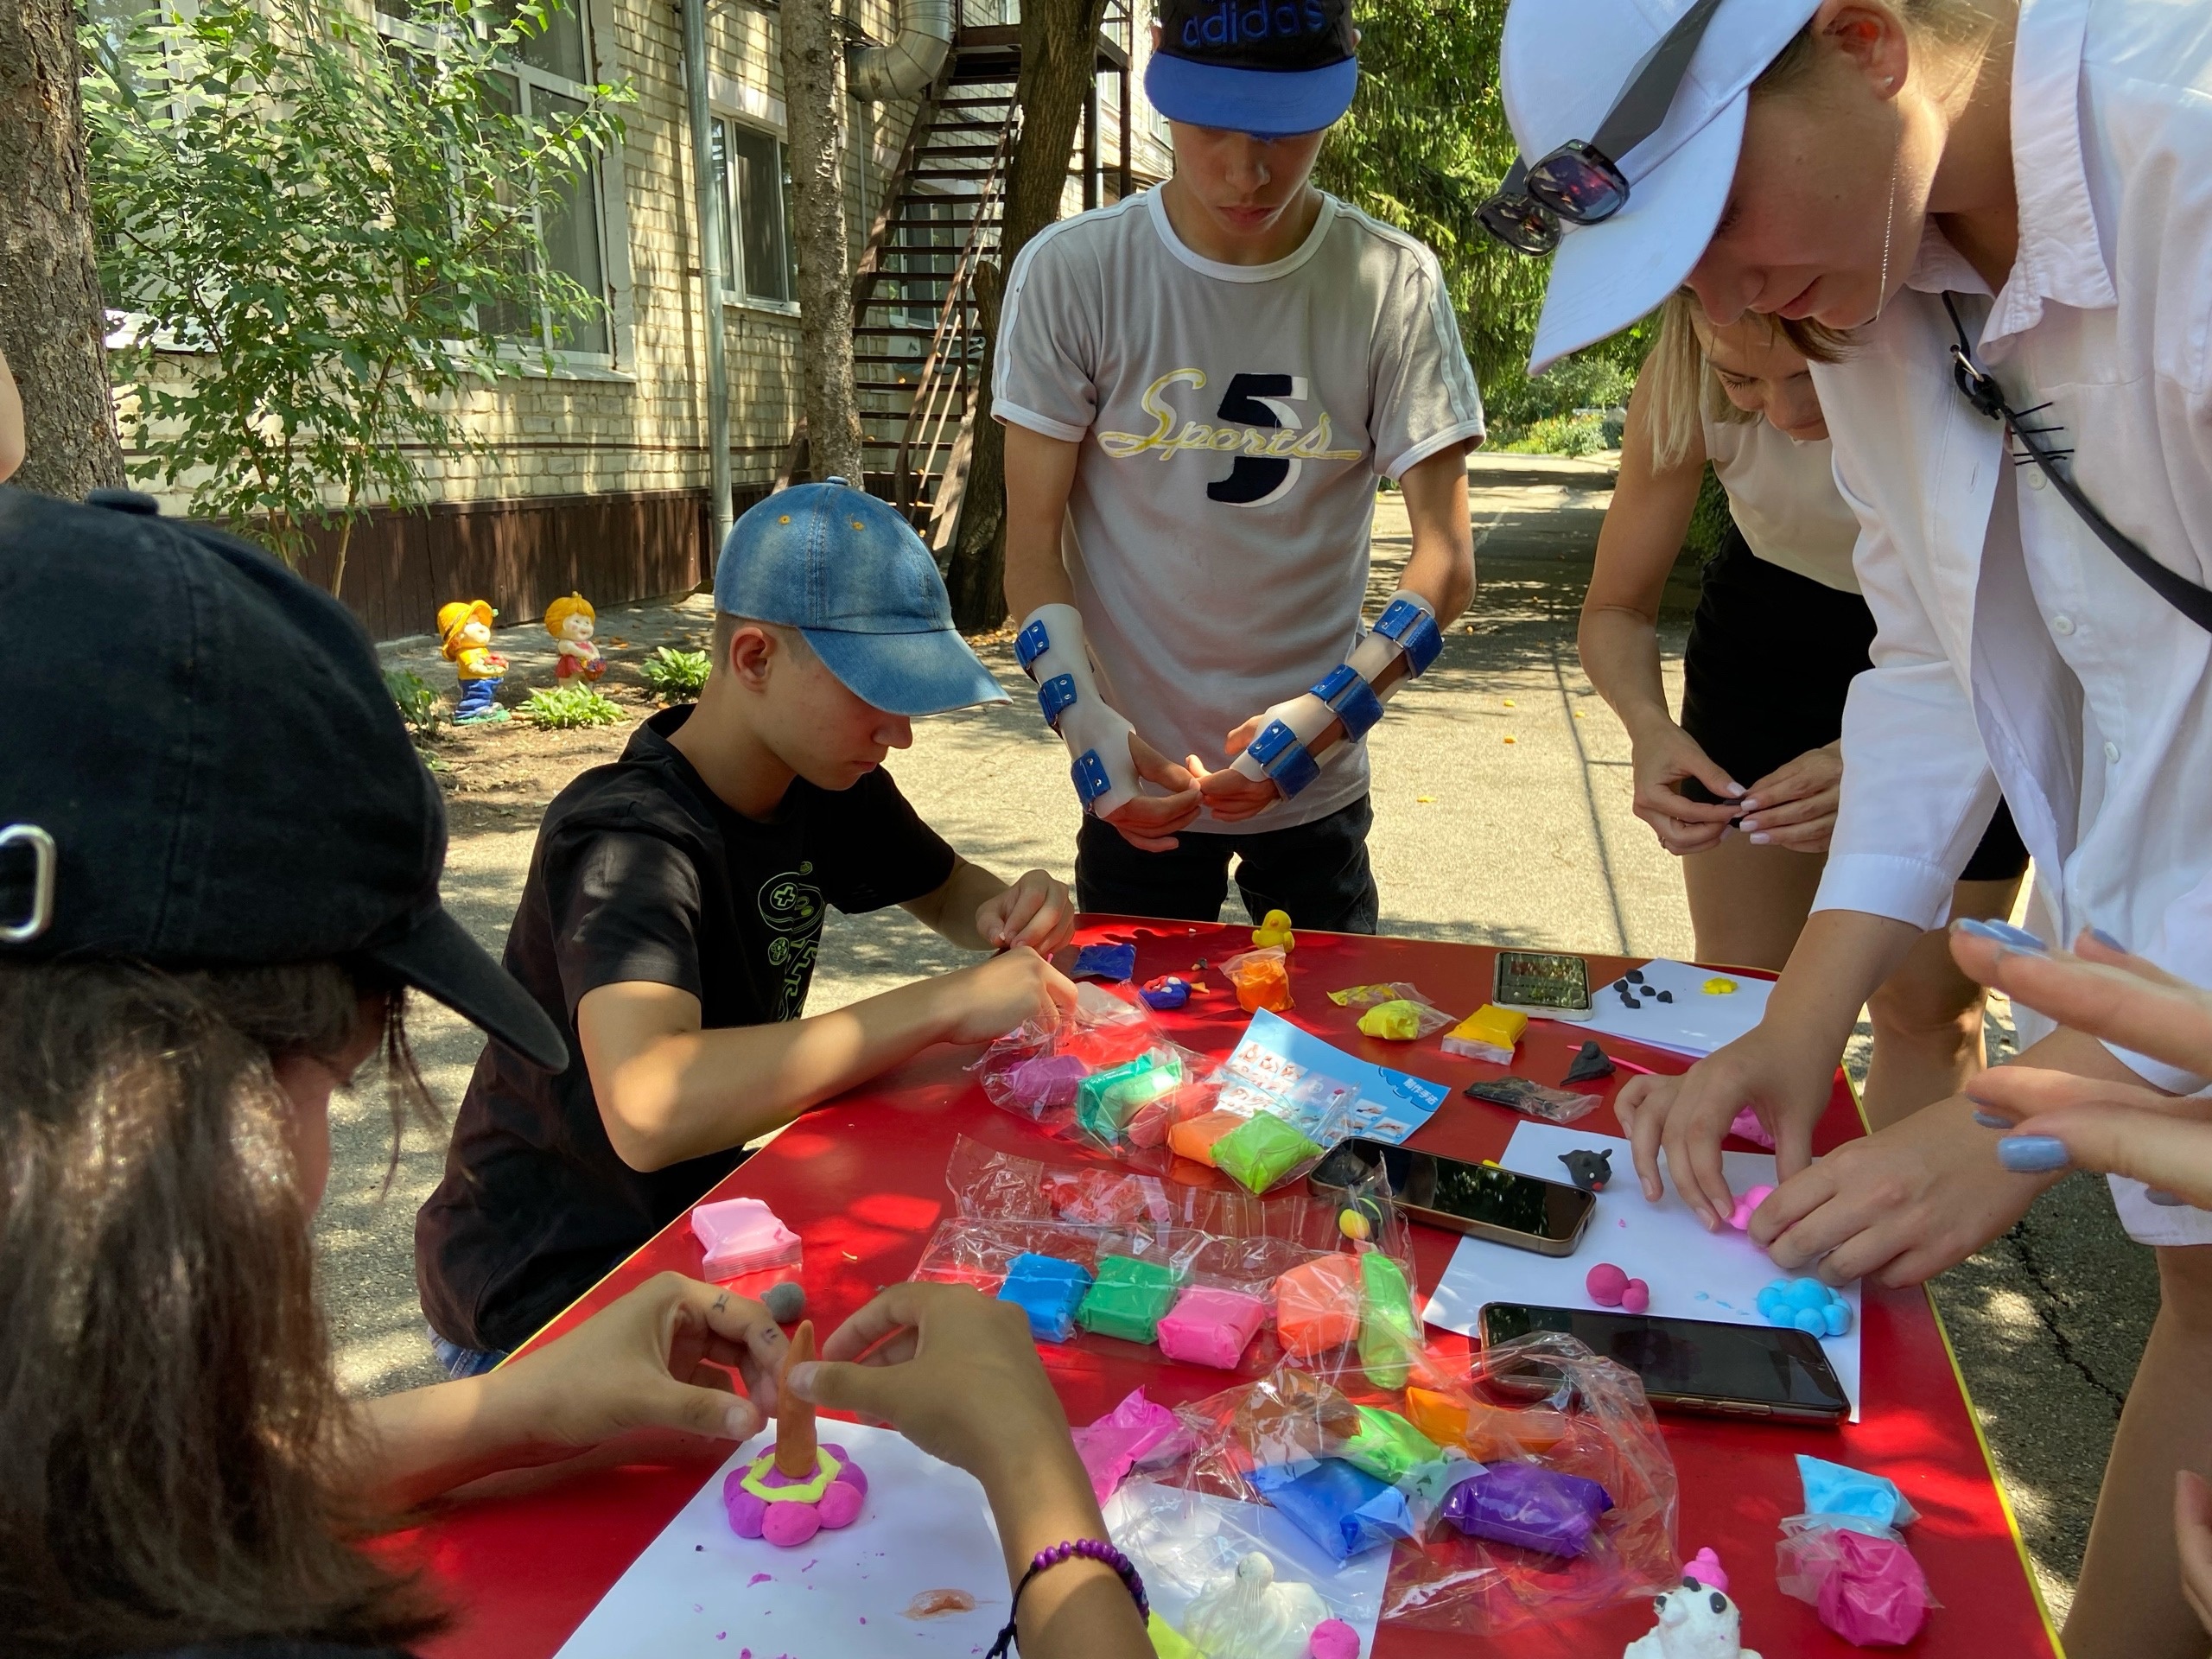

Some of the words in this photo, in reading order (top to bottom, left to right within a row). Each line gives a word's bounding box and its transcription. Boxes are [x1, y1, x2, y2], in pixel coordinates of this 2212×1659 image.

[1182, 0, 1325, 47] adidas
[1097, 368, 1362, 461] Sports
[1207, 372, 1308, 508] 5
